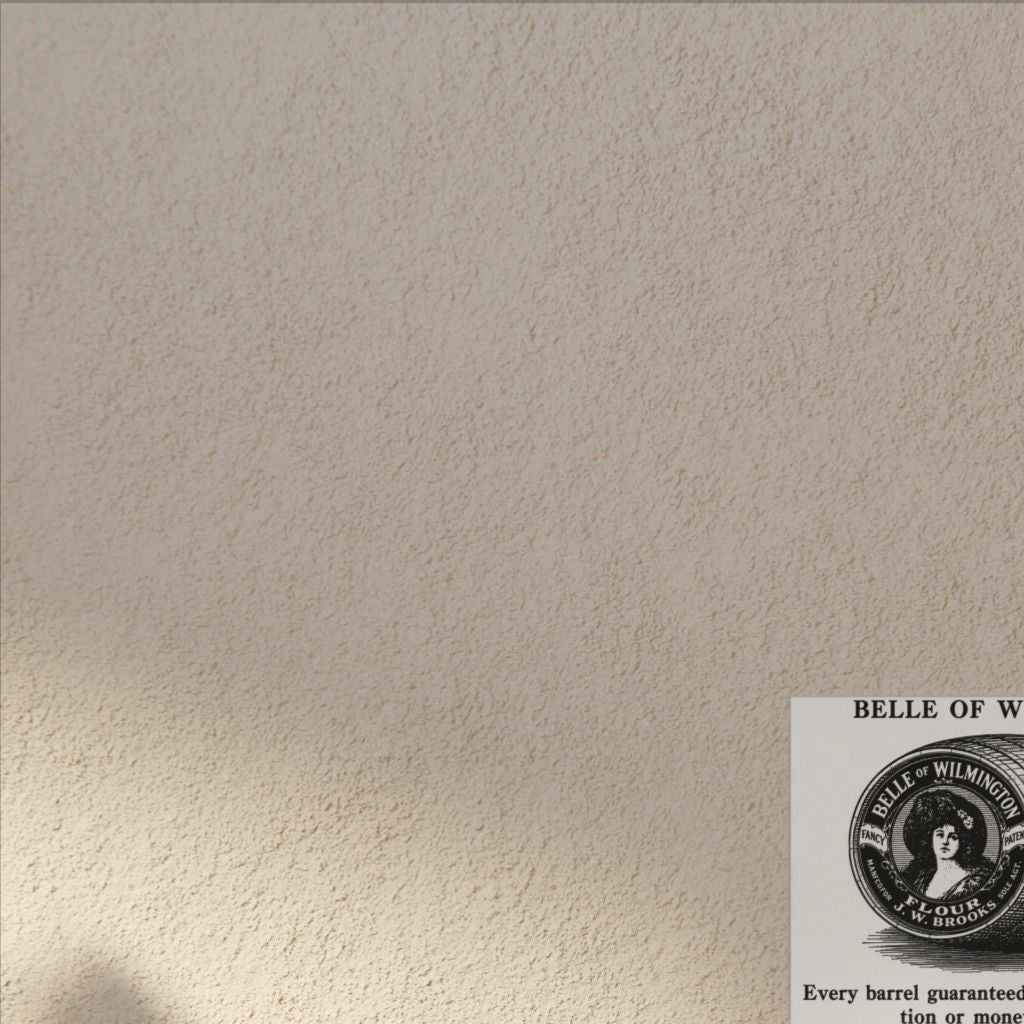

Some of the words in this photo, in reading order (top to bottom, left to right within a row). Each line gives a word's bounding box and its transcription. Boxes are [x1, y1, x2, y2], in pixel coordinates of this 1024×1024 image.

[853, 699, 939, 719] BELLE
[949, 699, 986, 719] OF
[871, 771, 916, 819] BELLE
[915, 766, 929, 778] OF
[932, 761, 1021, 820] WILMINGTON
[861, 829, 885, 846] FANCY
[893, 903, 905, 915] J.
[911, 909, 928, 925] W.
[904, 894, 982, 916] FLOUR
[802, 984, 859, 1005] Every
[865, 984, 920, 1001] barrel
[900, 1008, 937, 1024] tion
[945, 1012, 965, 1024] or
